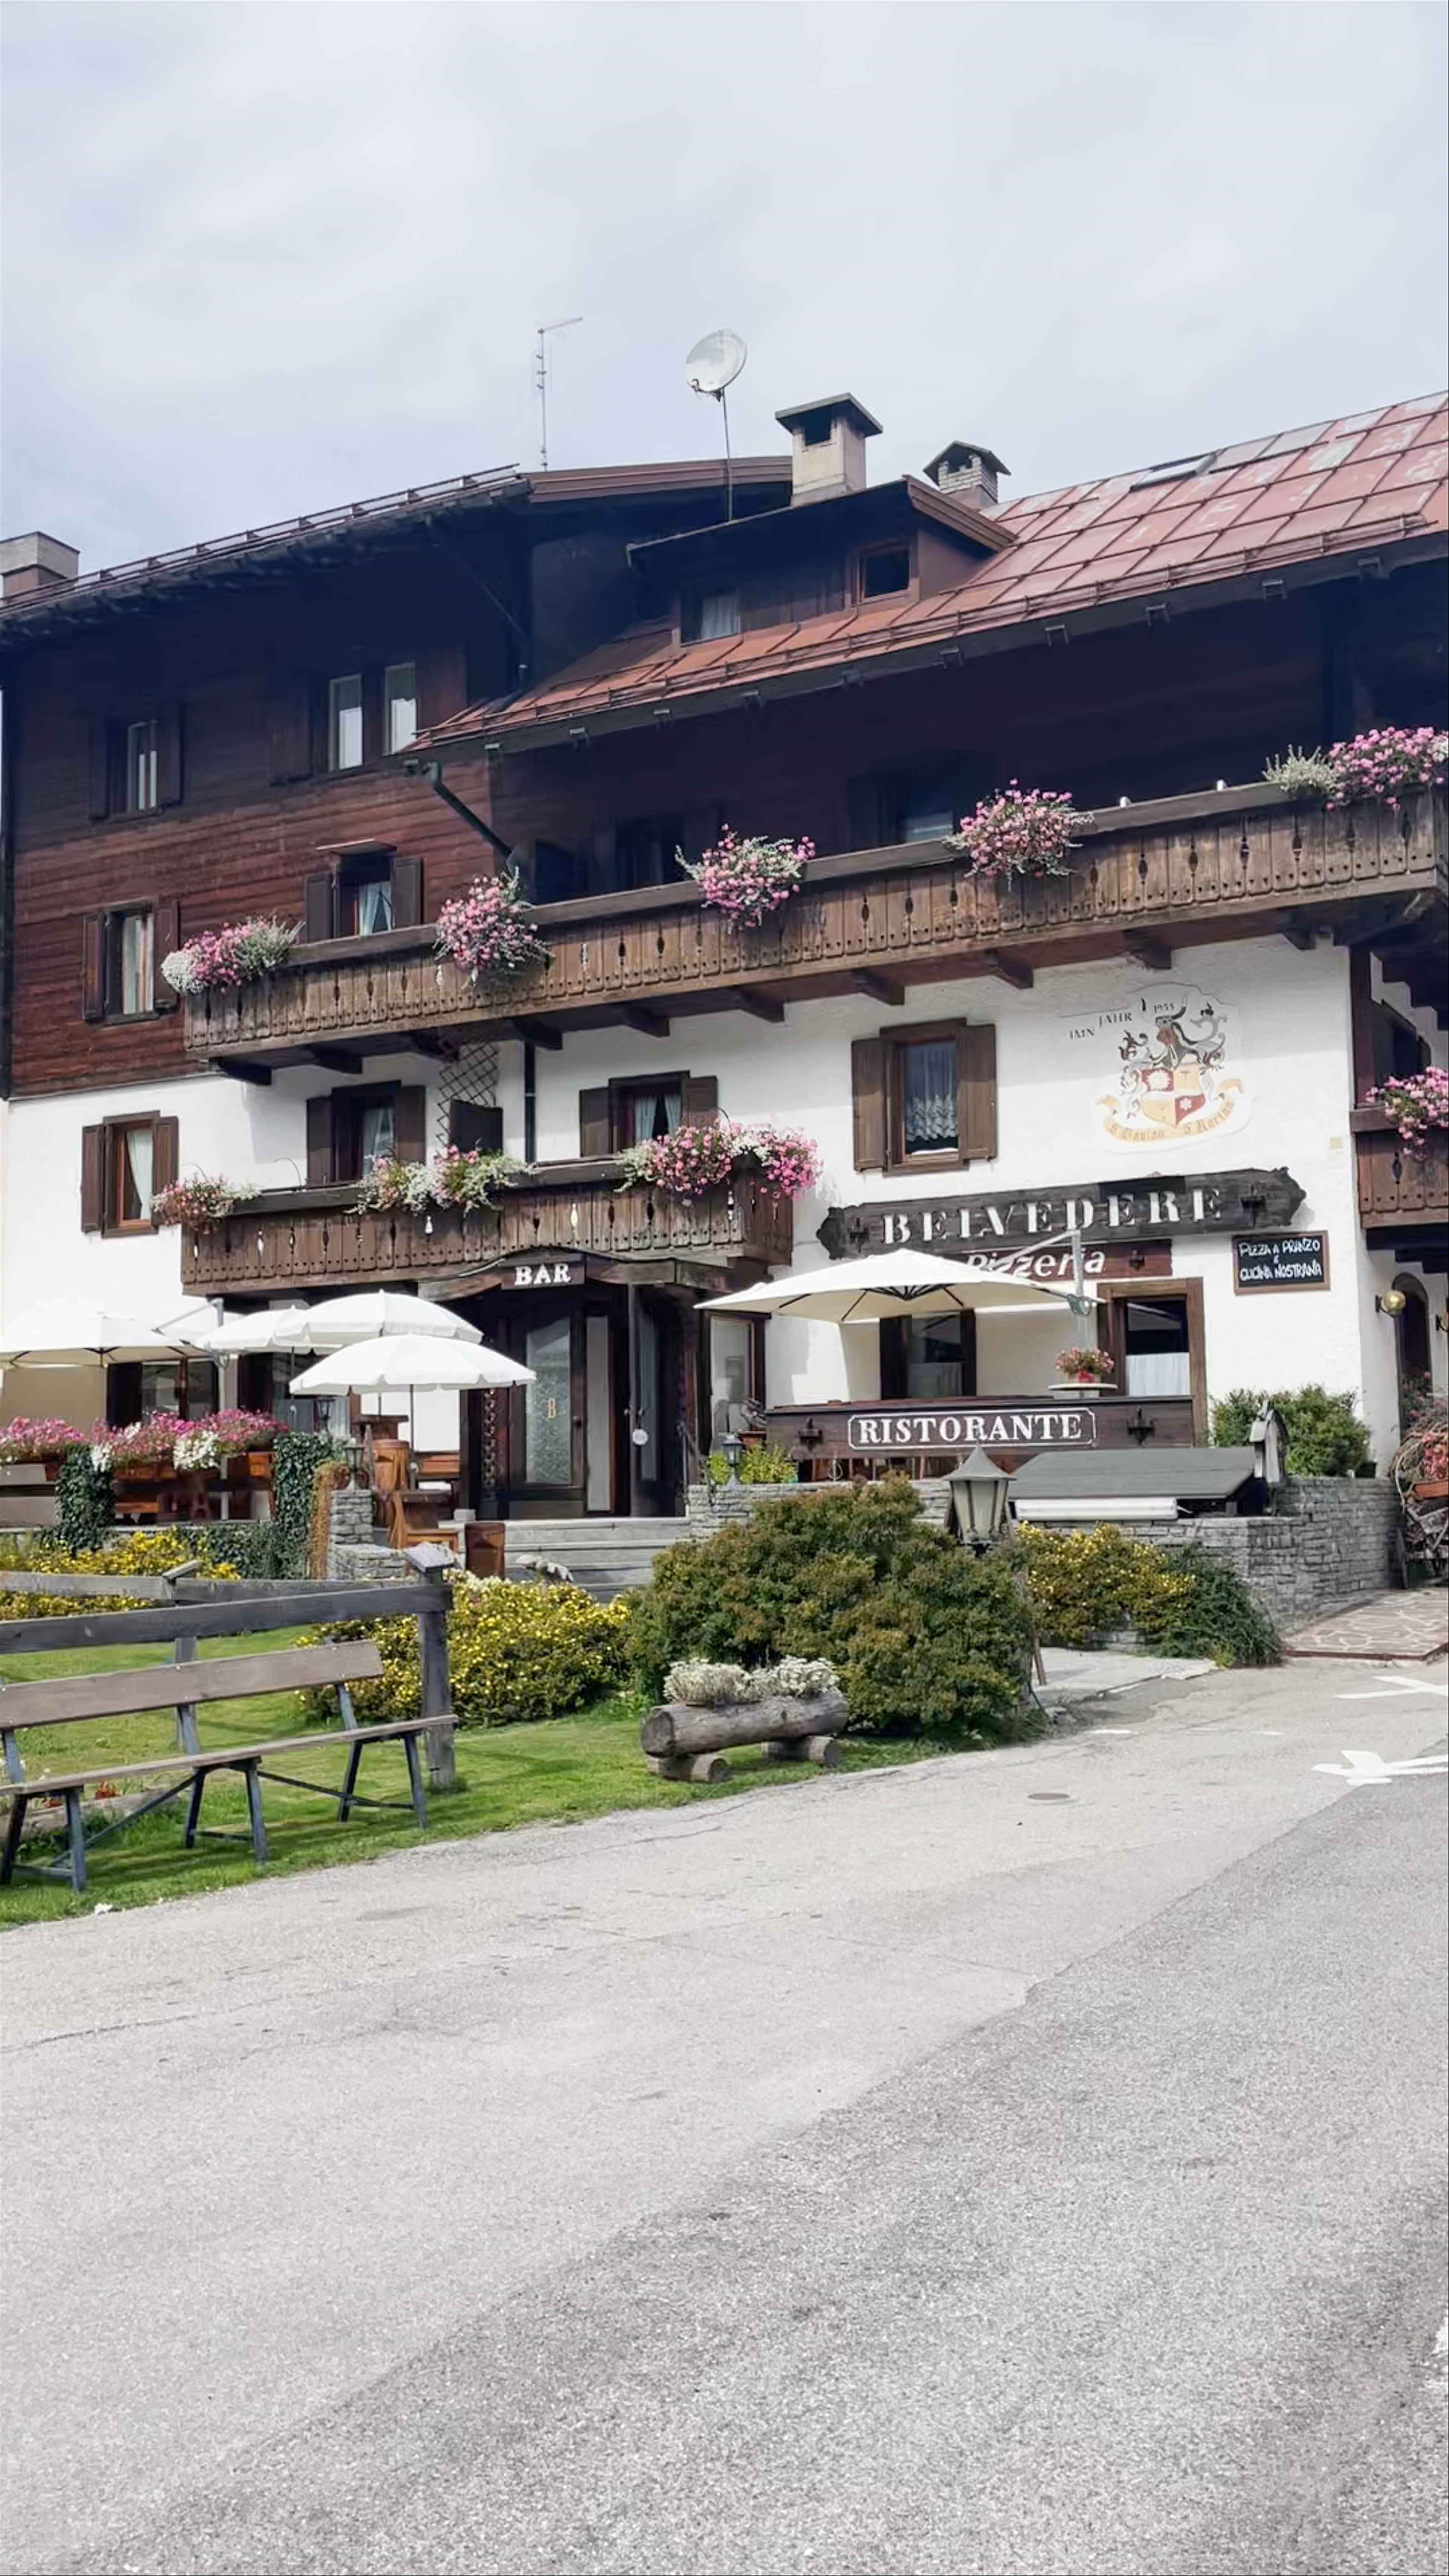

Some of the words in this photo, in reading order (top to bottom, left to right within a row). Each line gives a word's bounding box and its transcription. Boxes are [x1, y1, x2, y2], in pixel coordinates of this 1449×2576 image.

[884, 1189, 1221, 1244] BELVEDERE
[1239, 1243, 1271, 1257] PIZZA
[1282, 1238, 1320, 1254] PRANZO
[514, 1263, 572, 1286] BAR
[1240, 1264, 1273, 1281] CUCINA
[1275, 1259, 1322, 1278] NOSTRANA
[858, 1413, 1082, 1444] RISTORANTE
